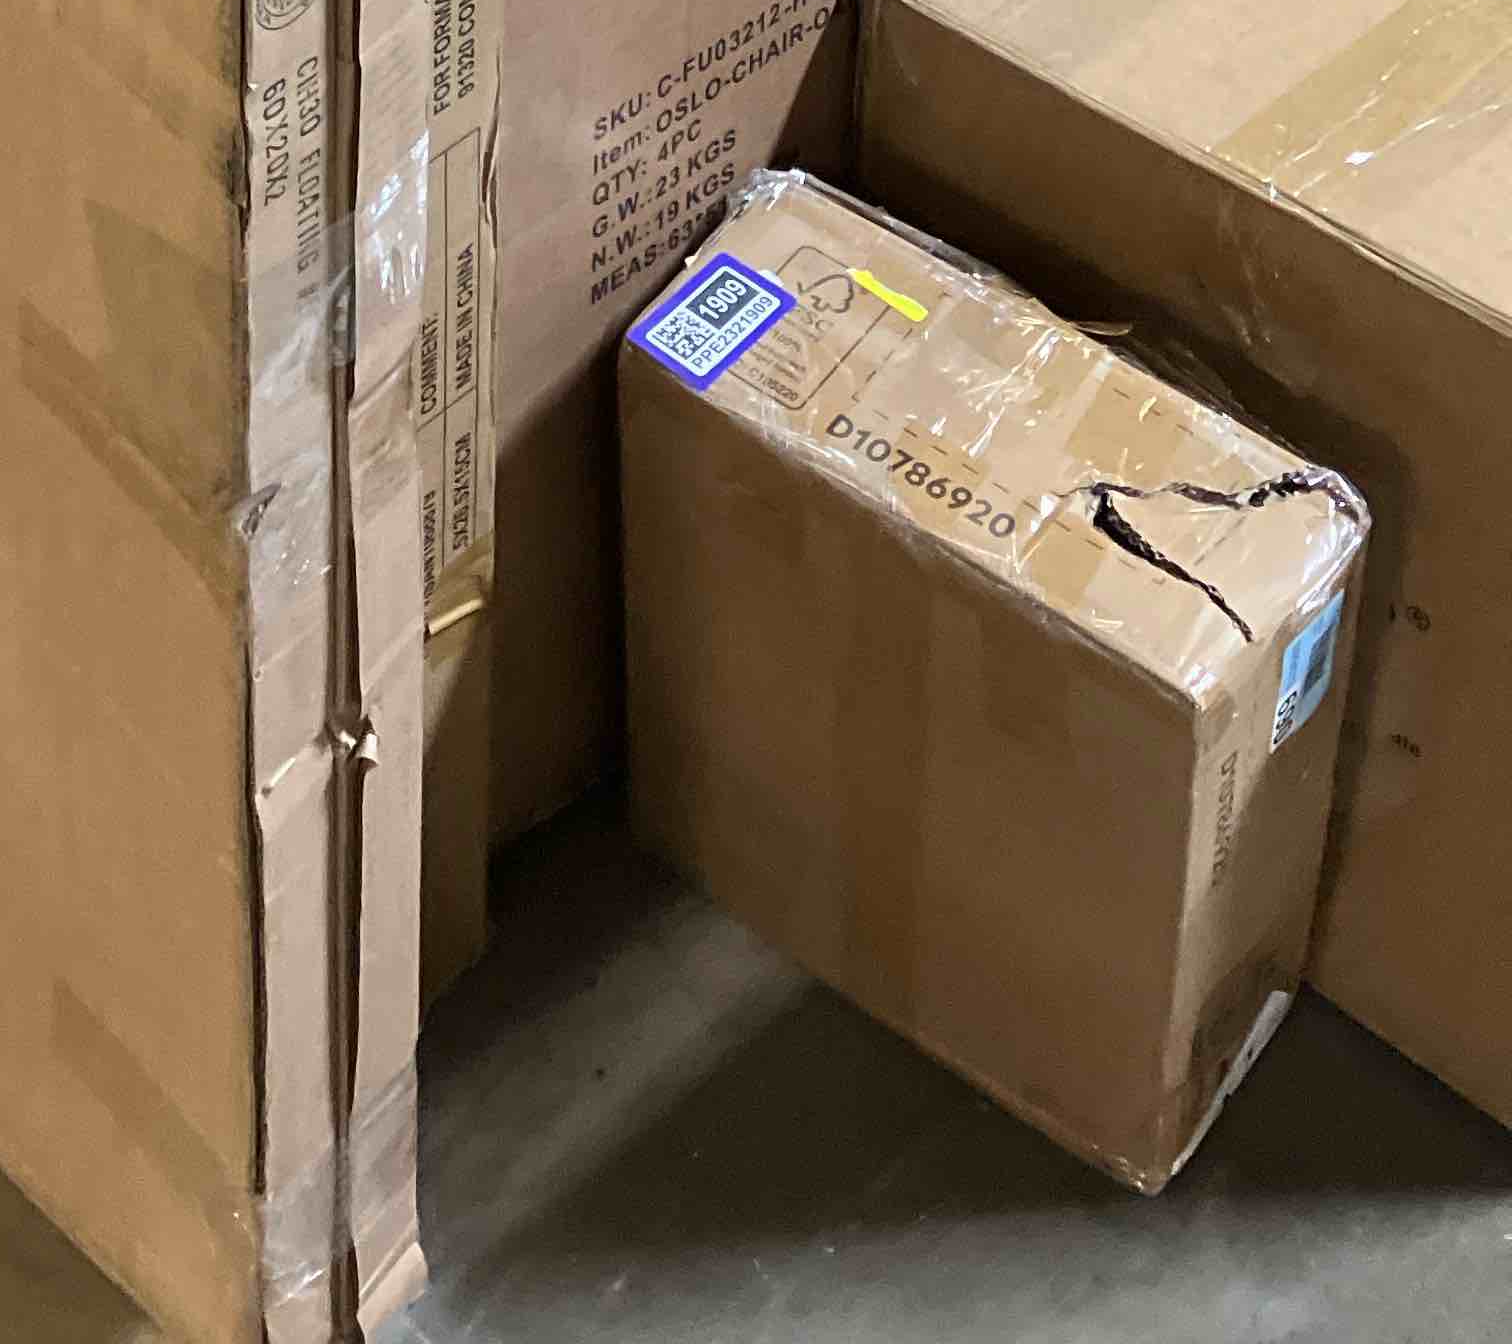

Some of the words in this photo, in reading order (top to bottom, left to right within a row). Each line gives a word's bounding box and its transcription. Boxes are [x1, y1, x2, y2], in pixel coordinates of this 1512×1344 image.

[433, 65, 451, 115] FOR
[457, 38, 475, 99] 91320
[263, 78, 291, 207] 60X20X2
[593, 92, 651, 140] SKU:
[593, 131, 650, 176] Item:
[593, 161, 647, 206] QTY:
[657, 119, 702, 162] 4PC
[688, 129, 737, 178] KGS
[686, 163, 736, 211] KGS
[456, 242, 474, 309] CHINA
[698, 279, 748, 320] 1909
[457, 309, 473, 329] IN
[692, 296, 773, 369] PPE2321909
[455, 329, 473, 391] MADE
[826, 414, 1016, 539] D10786920
